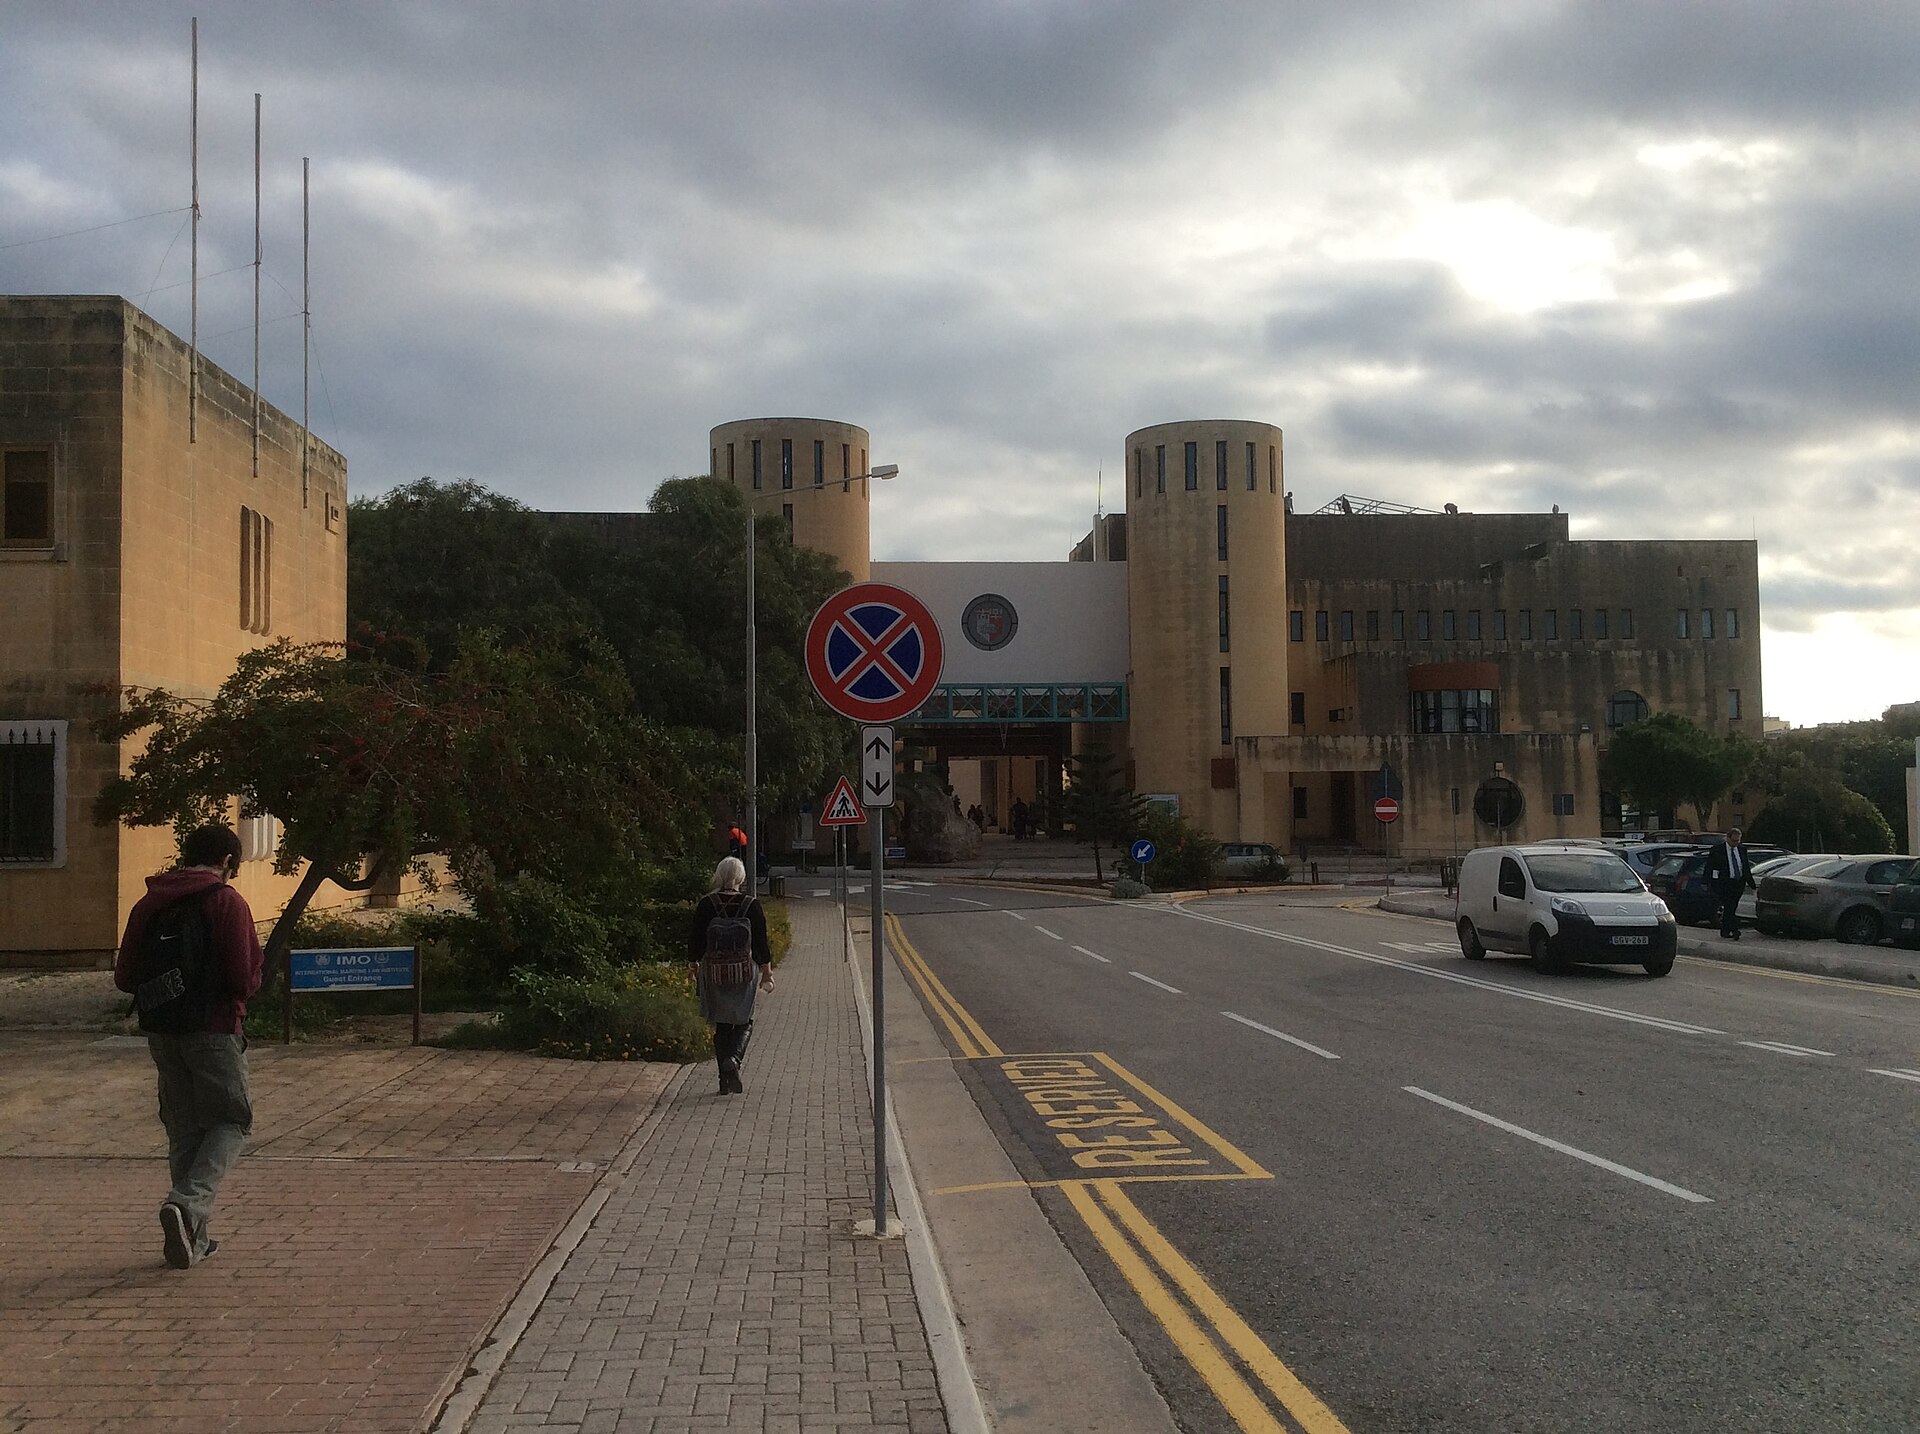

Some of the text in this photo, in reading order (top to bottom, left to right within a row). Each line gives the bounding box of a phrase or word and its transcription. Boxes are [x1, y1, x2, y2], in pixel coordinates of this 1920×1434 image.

[336, 956, 371, 965] IMO
[323, 974, 382, 984] Guest Entrance
[1000, 1059, 1209, 1168] RESERVED
